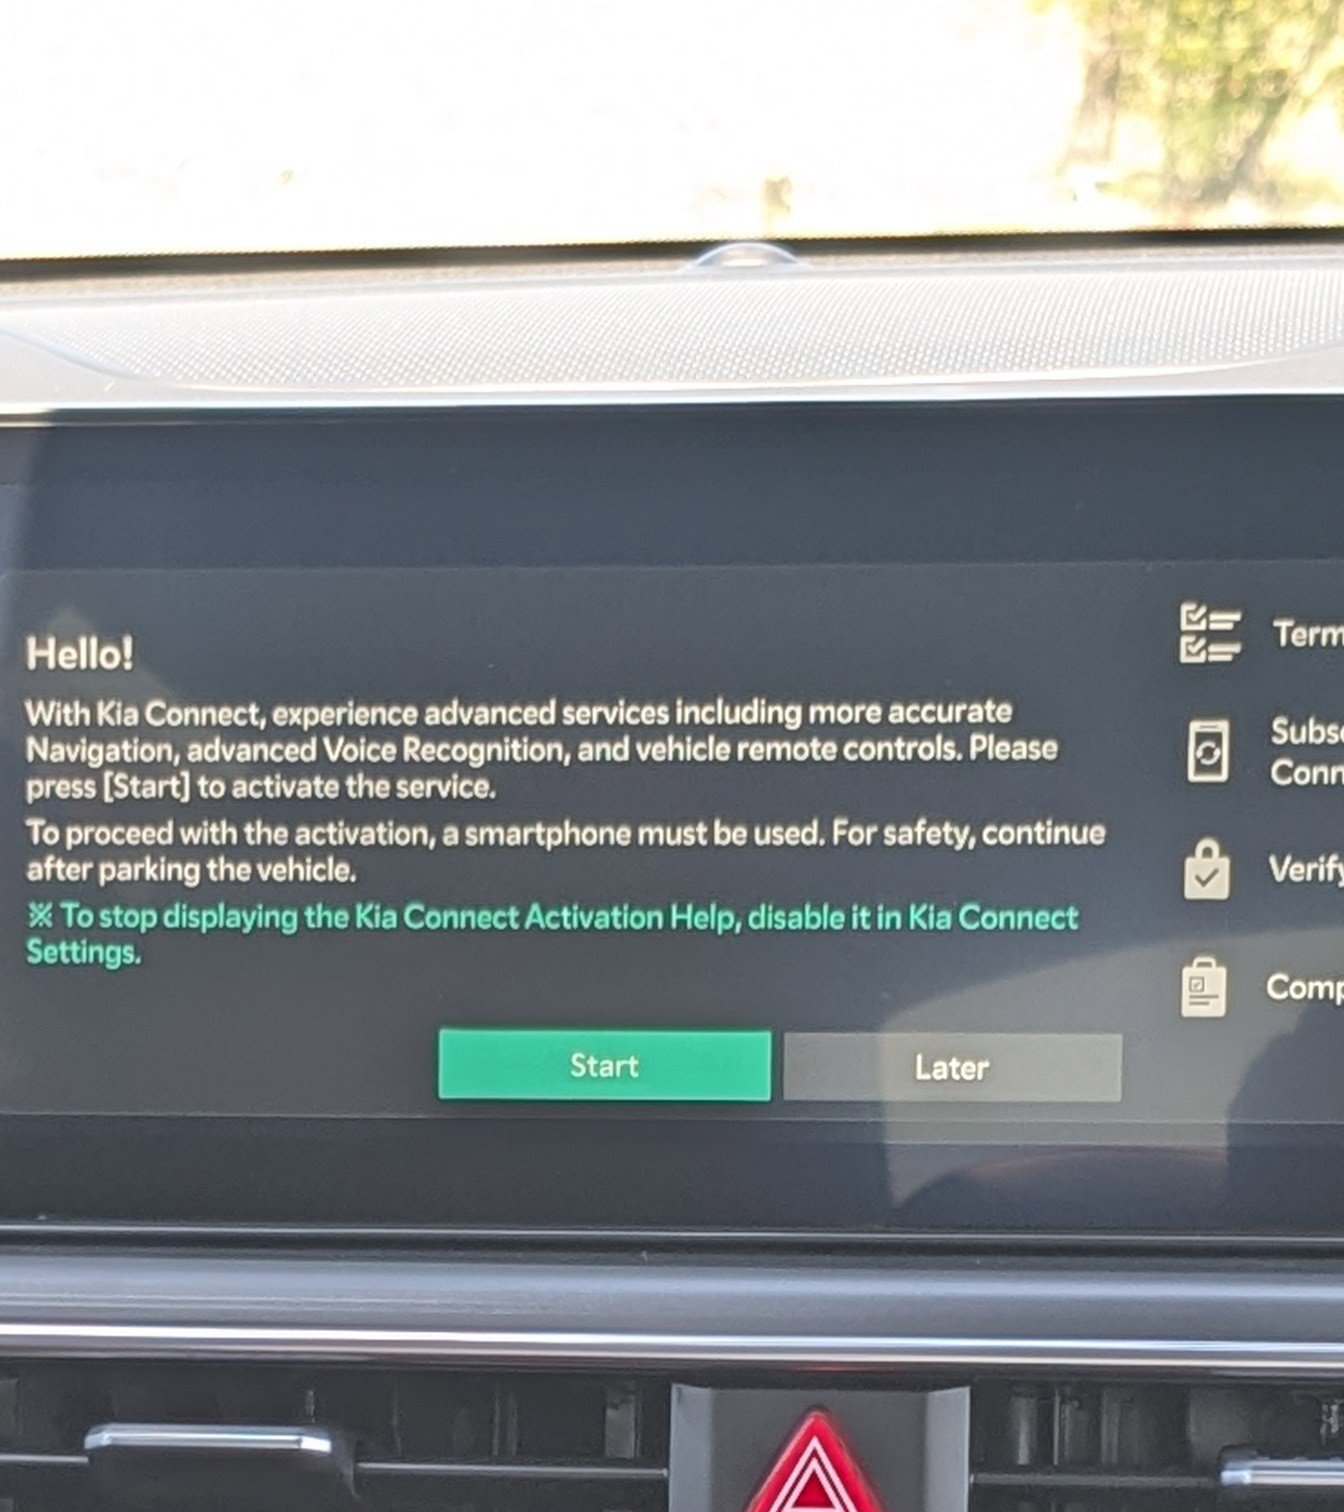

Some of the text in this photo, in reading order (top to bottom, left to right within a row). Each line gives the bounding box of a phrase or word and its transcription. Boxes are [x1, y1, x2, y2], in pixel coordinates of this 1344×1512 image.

[28, 636, 132, 670] Hello!
[25, 698, 1012, 731] With Kia Connect, experience advanced services including more accurate
[27, 734, 1058, 768] Navigation, advanced Voice Recognition, and vehicle remote controls. Please
[27, 770, 495, 803] press [Start] to activate the service.
[26, 818, 1105, 851] To proceed with the activation, a smartphone must be used. For safety, continue
[27, 855, 356, 887] after parking the vehicle.
[60, 902, 93, 927] To
[100, 906, 157, 933] stop
[163, 903, 297, 934] displaying
[304, 903, 349, 928] the
[356, 903, 397, 929] Kia
[404, 903, 515, 929] Connect
[525, 903, 665, 931] Activation
[672, 903, 741, 935] Help,
[749, 903, 845, 929] disable
[853, 905, 870, 929] it
[878, 905, 901, 929] in
[910, 904, 951, 929] Kia
[959, 904, 1078, 929] Connect
[27, 938, 141, 969] Settings.
[572, 1053, 638, 1077] Start
[917, 1054, 990, 1080] Later
